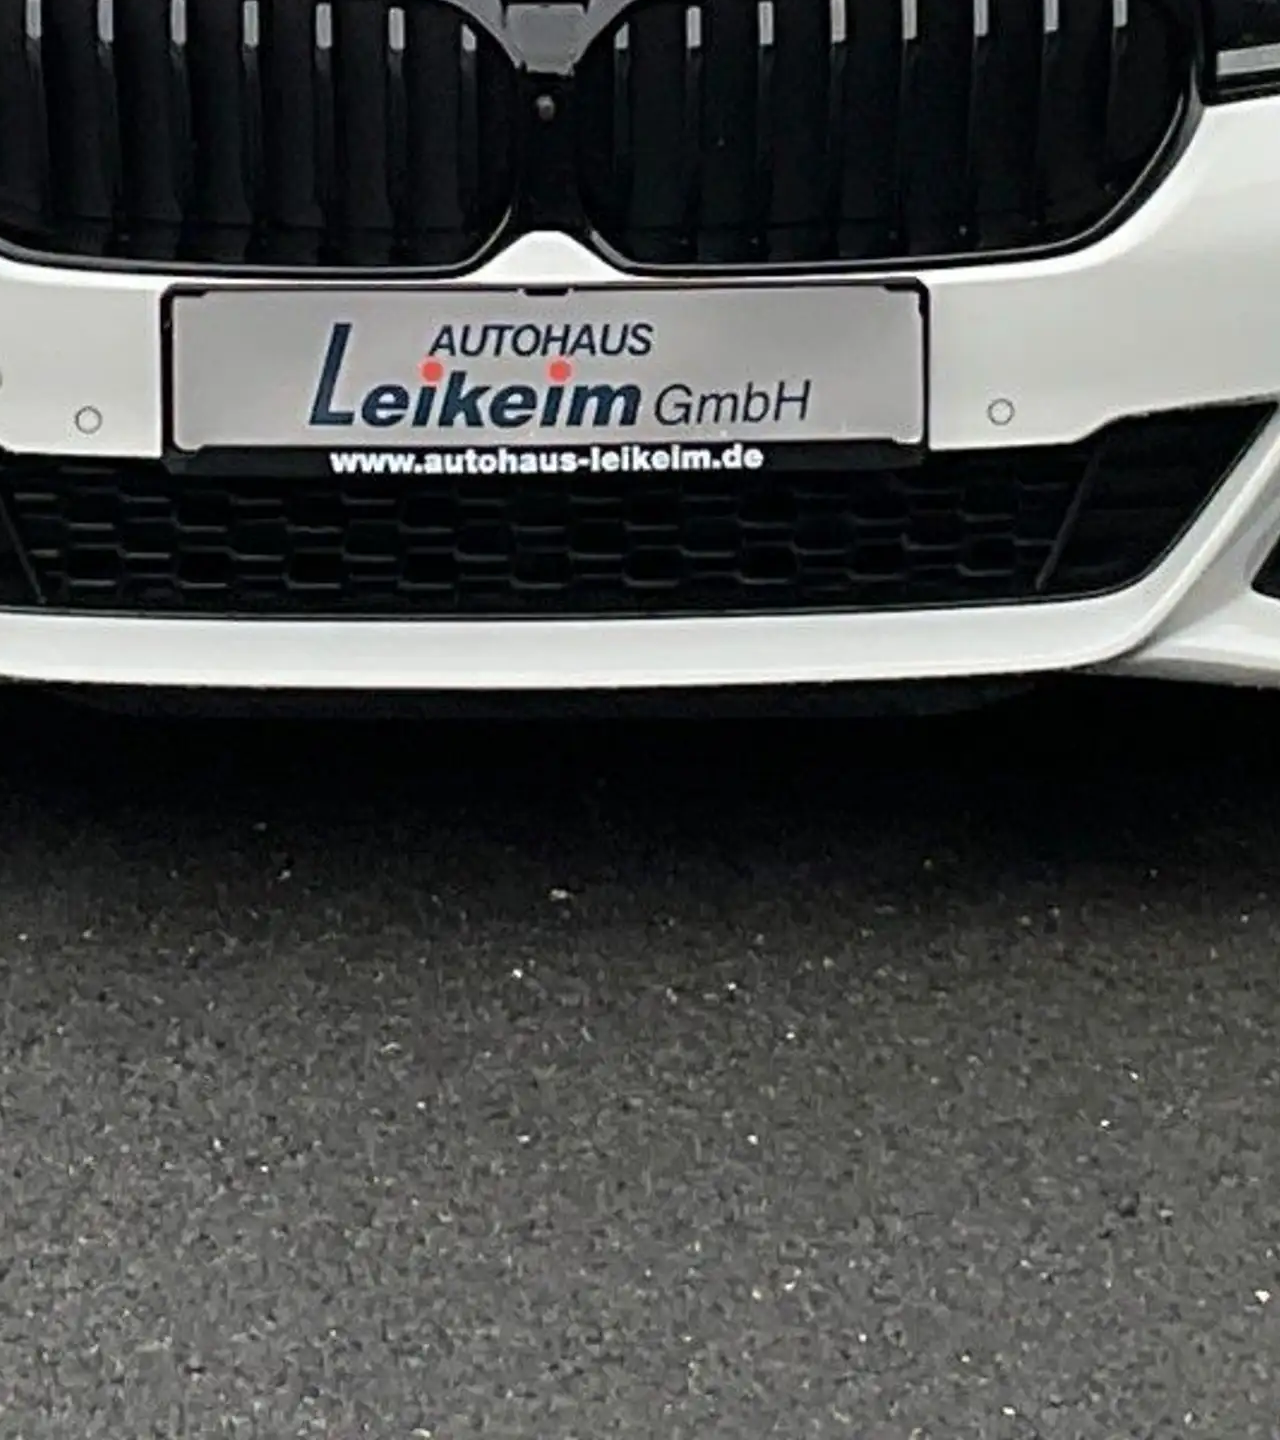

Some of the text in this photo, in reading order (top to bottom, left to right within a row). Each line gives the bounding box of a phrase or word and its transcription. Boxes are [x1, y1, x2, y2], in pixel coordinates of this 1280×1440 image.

[427, 322, 654, 358] AUTOHAUS
[308, 322, 812, 429] Leikeim GmbH
[329, 443, 764, 474] www.autohaus-leikeim.de
